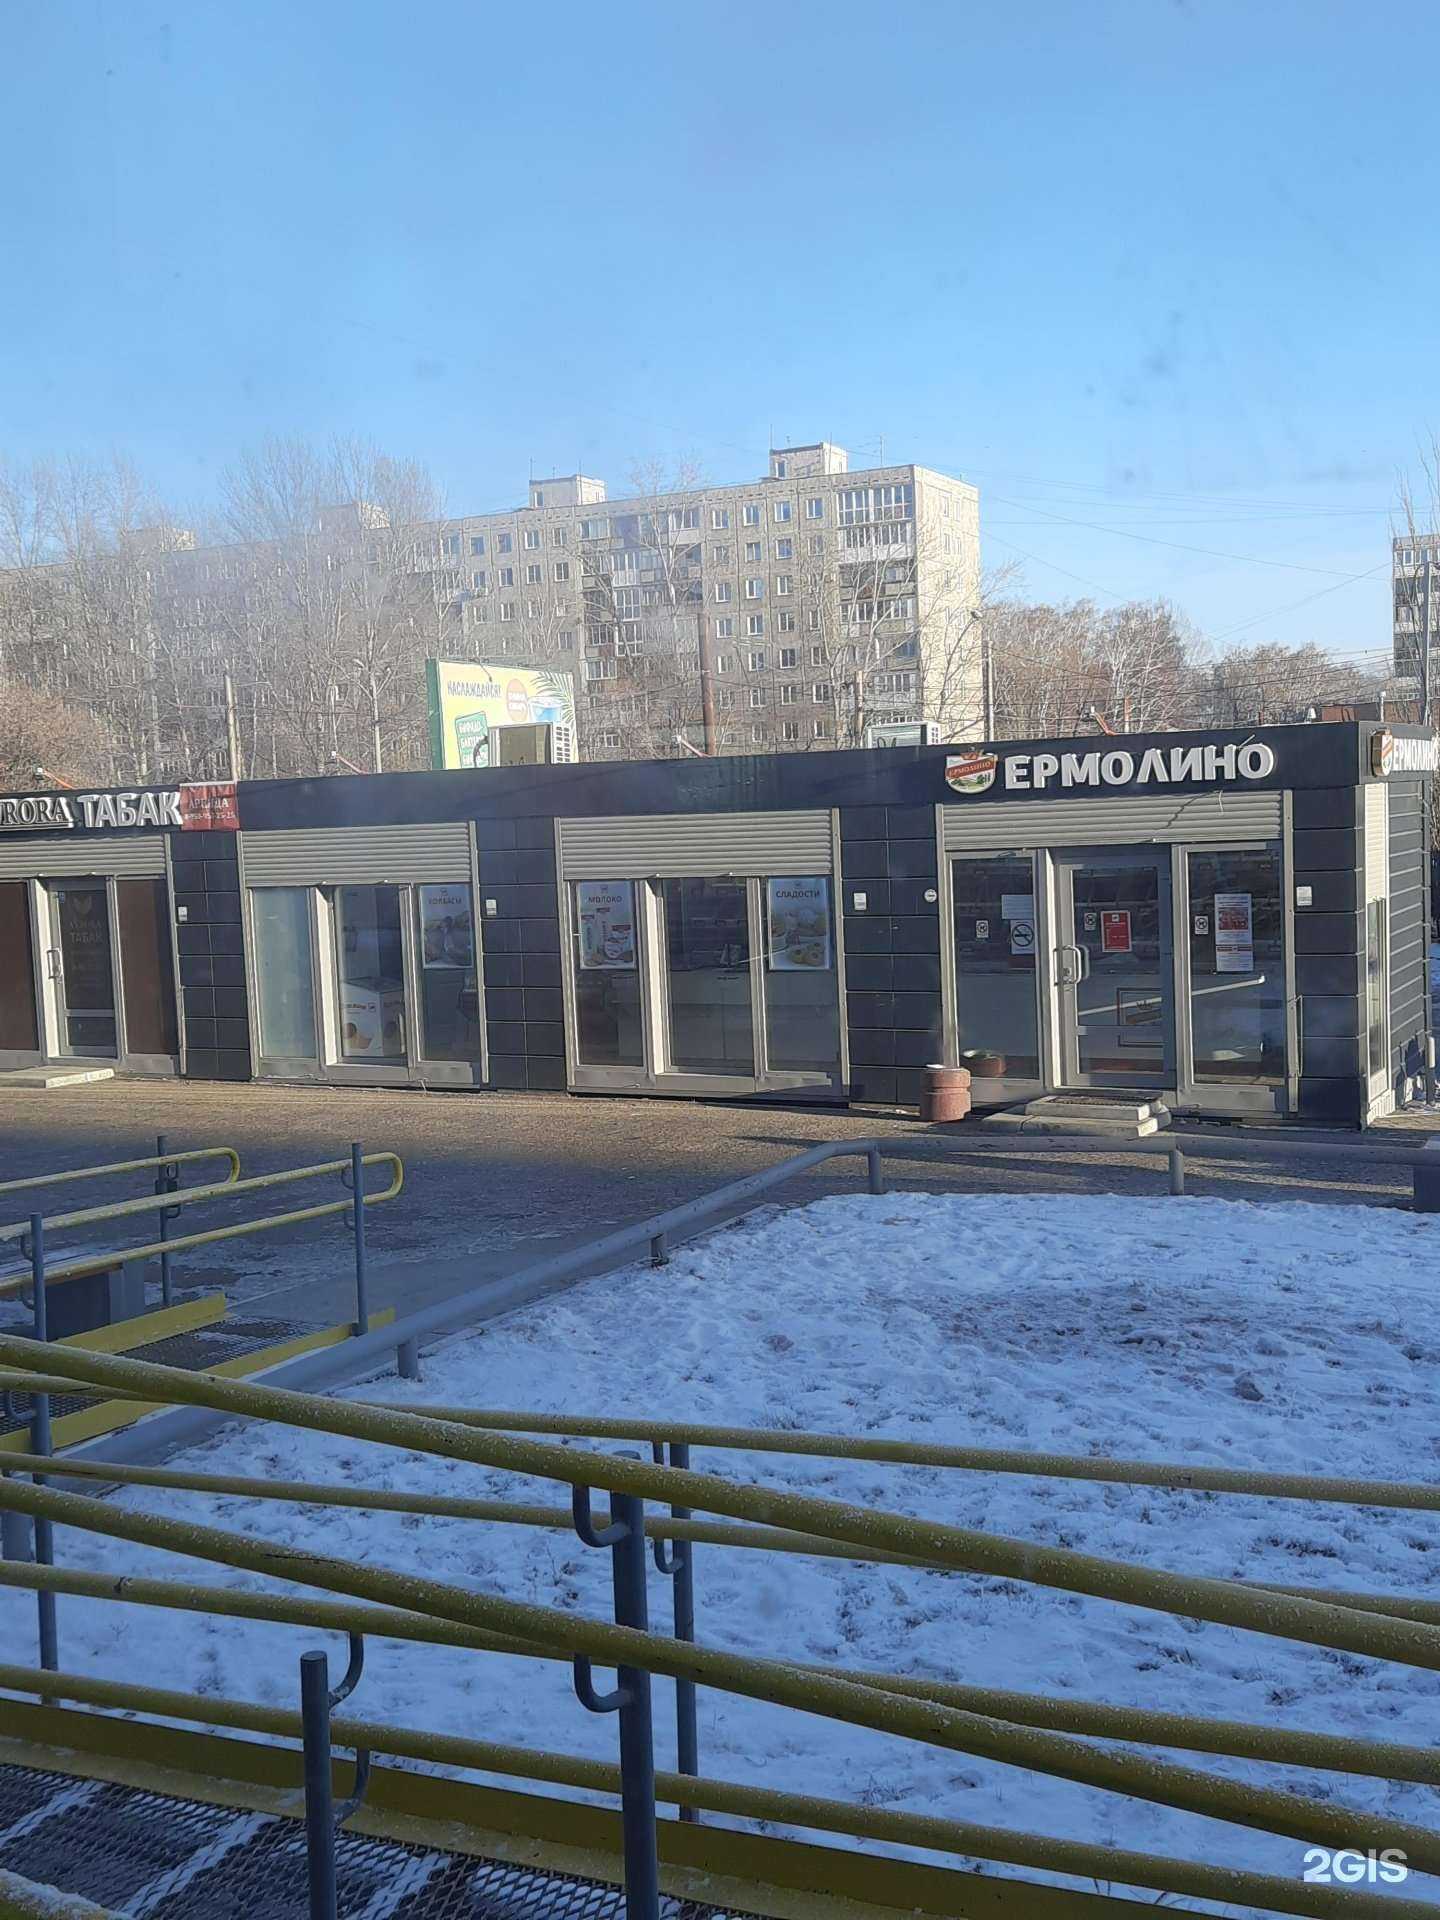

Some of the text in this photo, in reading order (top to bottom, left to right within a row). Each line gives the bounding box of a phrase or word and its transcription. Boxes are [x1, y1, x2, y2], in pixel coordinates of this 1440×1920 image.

[1004, 743, 1275, 789] ЕРМОЛИНО
[77, 791, 183, 828] ТАБАК
[587, 895, 623, 904] МОЛОКО
[775, 889, 821, 899] СЛАДОСТИ
